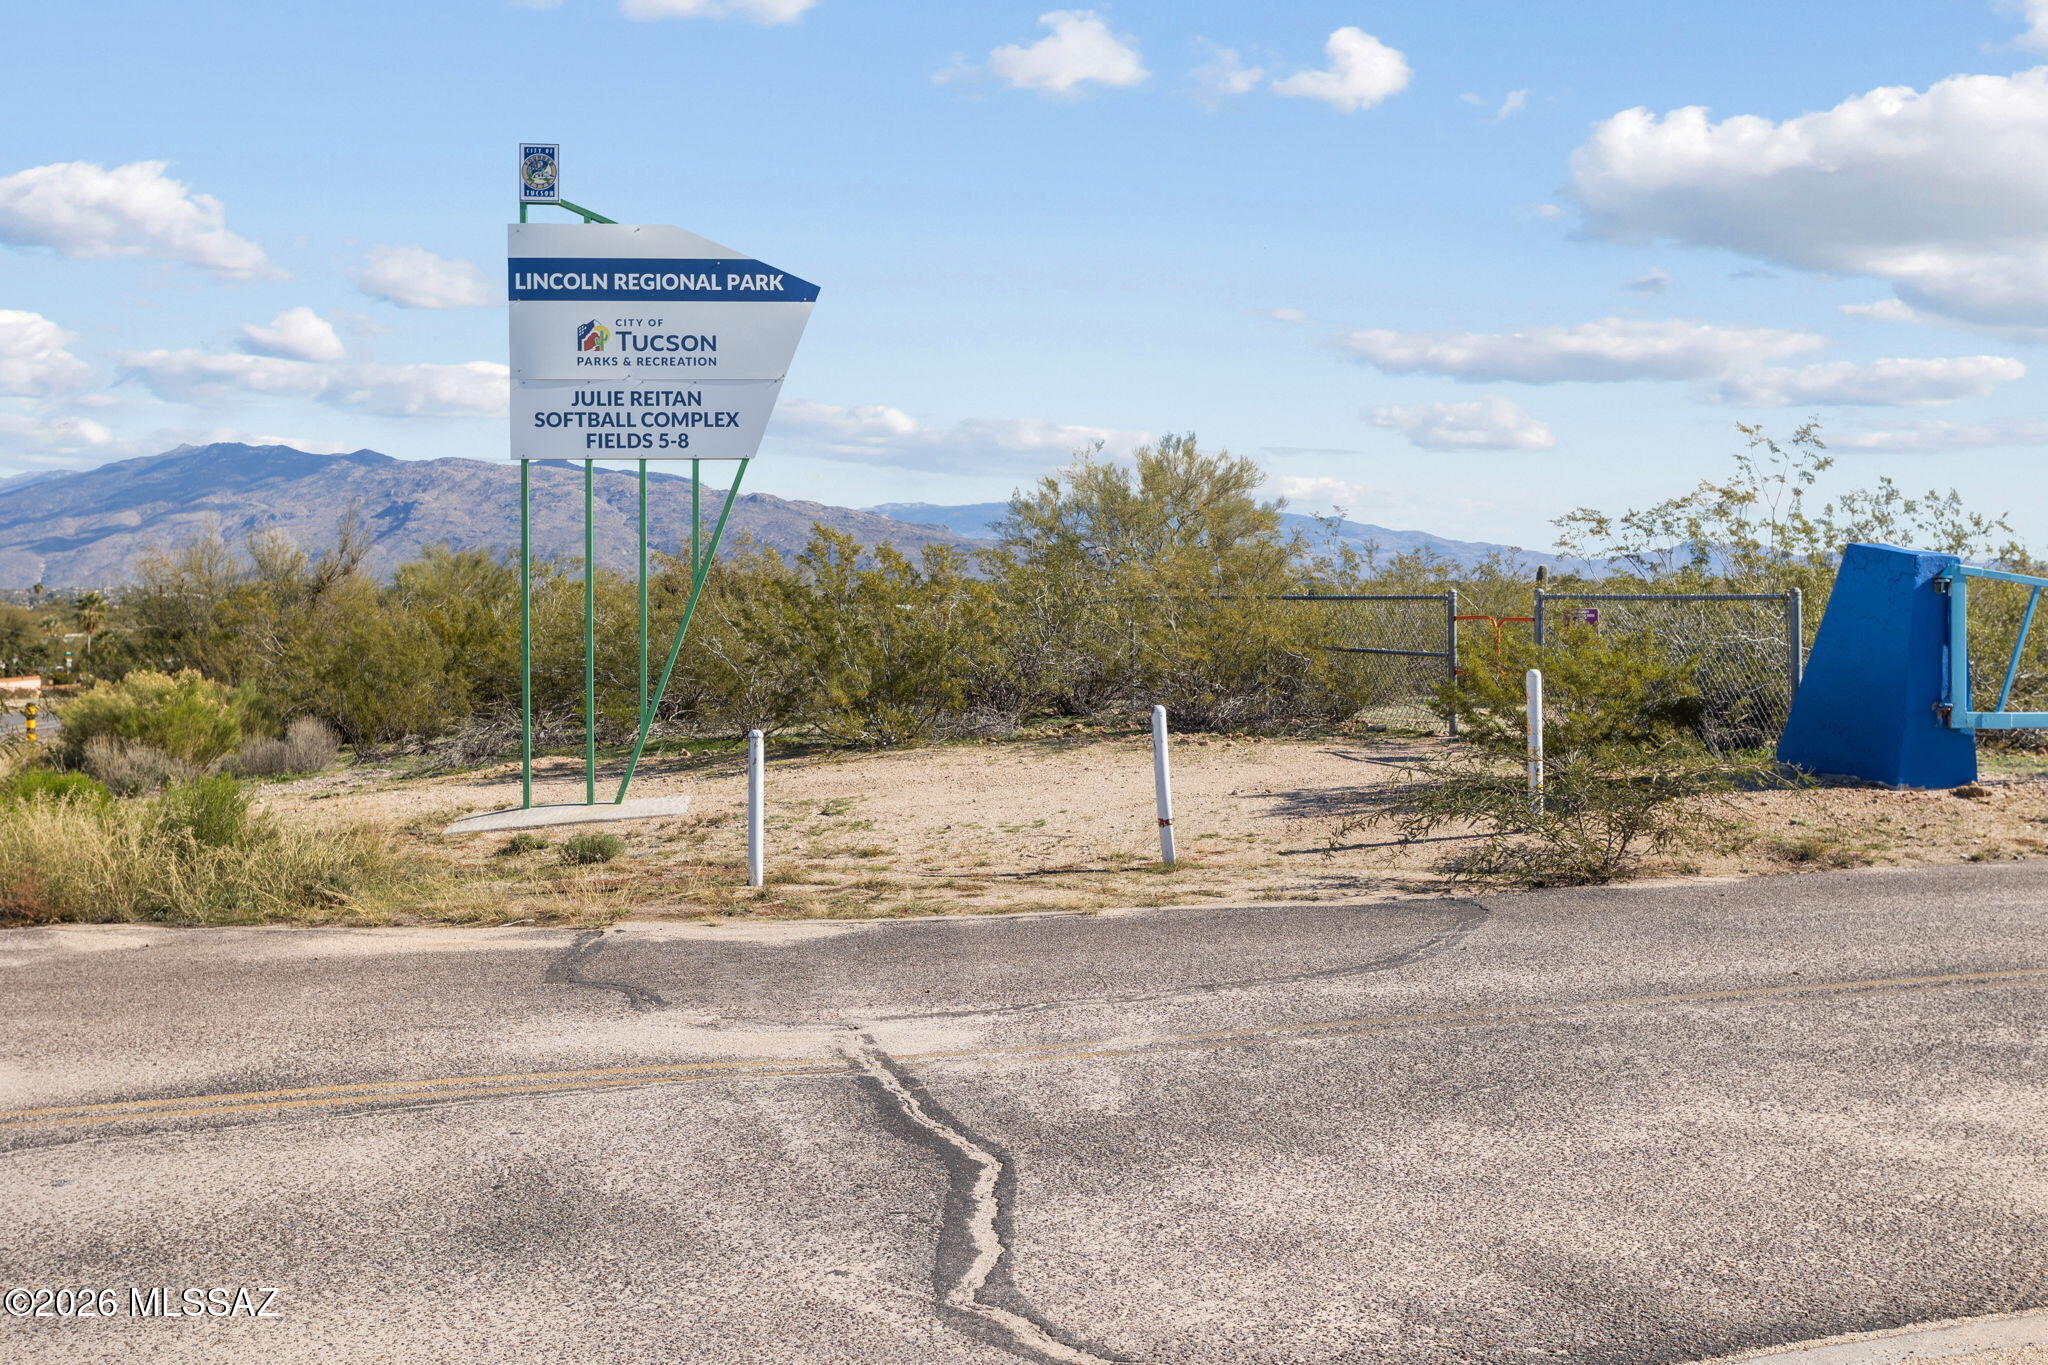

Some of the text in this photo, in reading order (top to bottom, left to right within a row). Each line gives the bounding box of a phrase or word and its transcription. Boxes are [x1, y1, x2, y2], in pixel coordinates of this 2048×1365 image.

[515, 272, 785, 292] LINCOLN REGIONAL PARK
[615, 318, 664, 327] CITY OF
[616, 331, 717, 352] TUCSON
[577, 356, 717, 367] PARKS & RECREATION
[571, 390, 702, 407] JULIE REITAN
[534, 412, 740, 428] SOFTBALL COMPLEX
[586, 432, 690, 449] FIELDS 5-8
